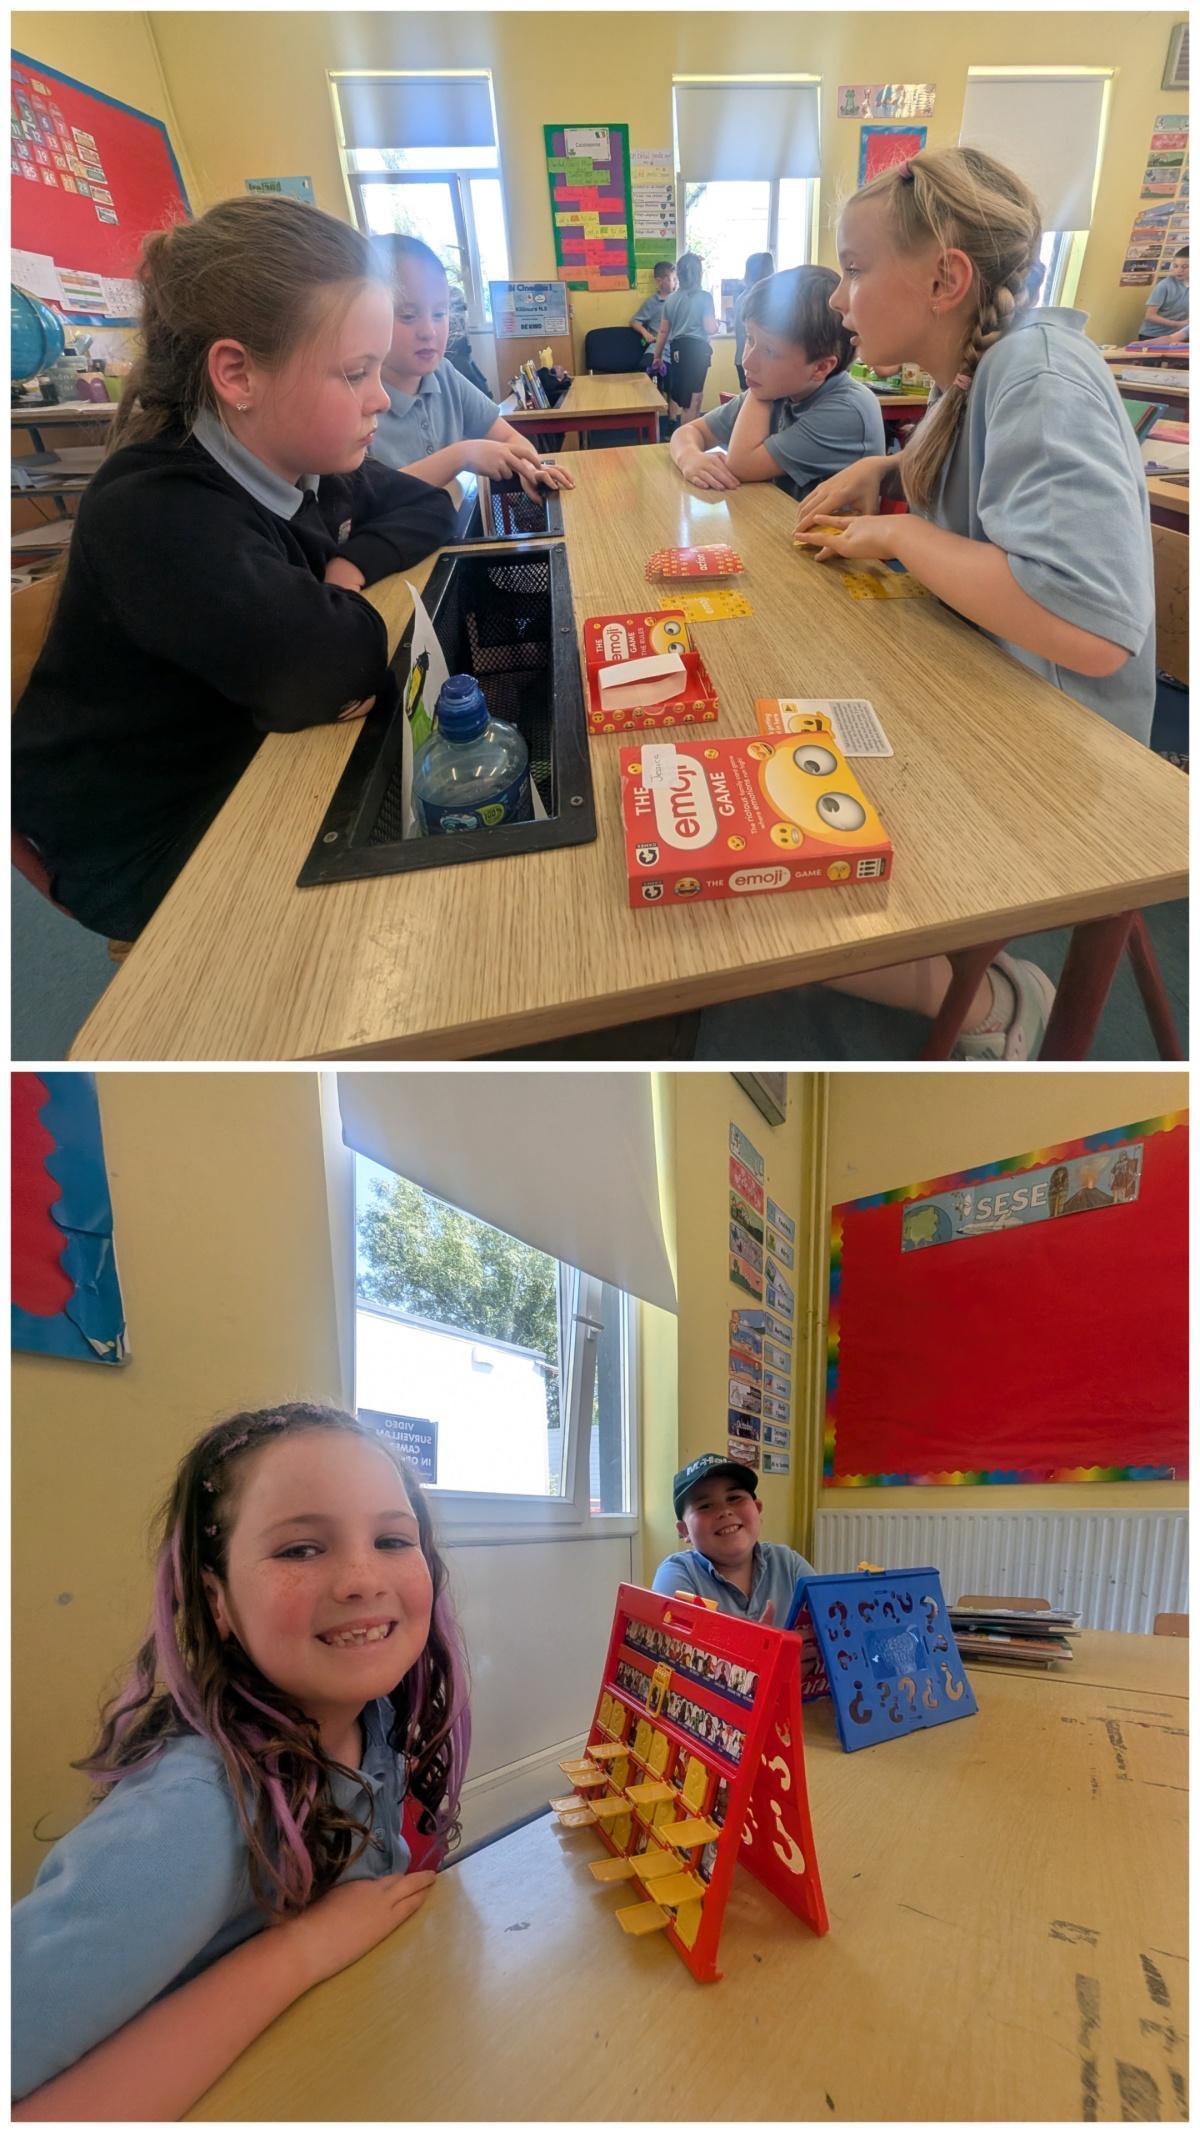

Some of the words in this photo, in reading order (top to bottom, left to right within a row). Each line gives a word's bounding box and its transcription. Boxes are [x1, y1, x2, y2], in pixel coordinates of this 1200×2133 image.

[696, 553, 708, 571] action
[606, 628, 623, 660] emoji
[627, 631, 637, 653] GAME
[638, 627, 646, 644] RULES
[595, 639, 604, 653] THE
[640, 645, 648, 656] THE
[633, 787, 651, 816] THE
[709, 771, 735, 816] GAME
[750, 822, 758, 834] The
[706, 880, 724, 888] THE
[734, 870, 784, 887] emoji
[795, 869, 822, 879] GAME
[975, 1183, 1049, 1220] SESE
